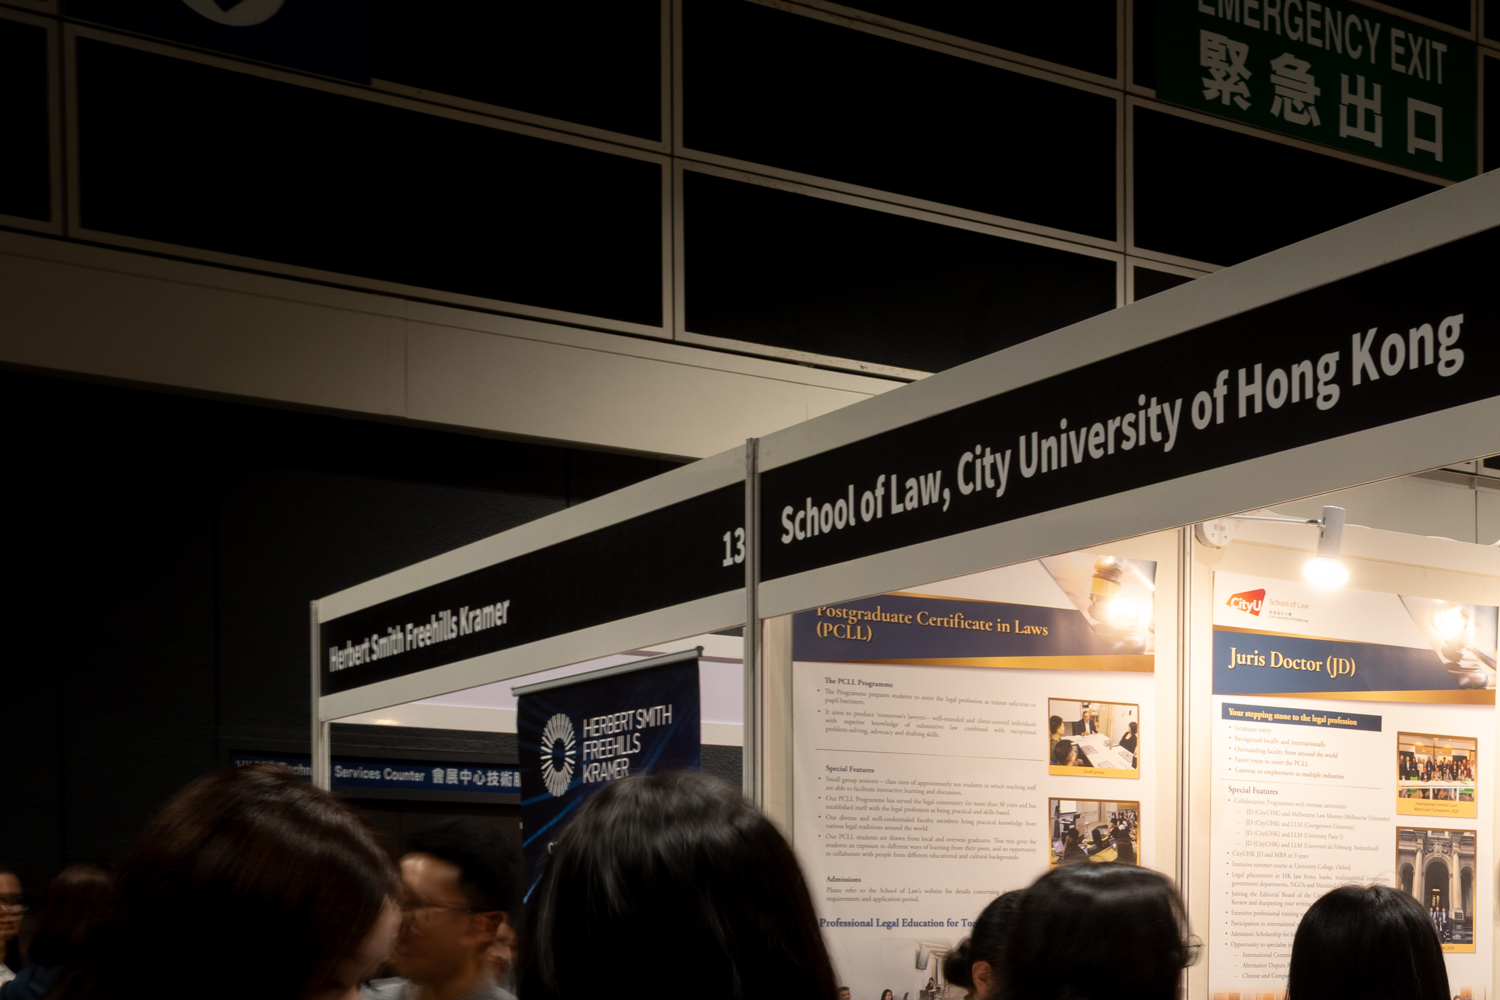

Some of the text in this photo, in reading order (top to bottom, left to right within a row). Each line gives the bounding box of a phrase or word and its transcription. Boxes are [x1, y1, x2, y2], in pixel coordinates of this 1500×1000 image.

[1198, 0, 1447, 84] MERGENCY EXIT
[1200, 29, 1443, 162] 緊急出口
[781, 312, 1464, 544] School of Law, City University of Hong Kong
[723, 527, 745, 567] 13
[1231, 597, 1262, 612] CityU
[1269, 599, 1289, 607] School
[817, 606, 1049, 636] Postgraduate Certificate in Laws
[329, 600, 510, 672] Herbert Smith Freehills Kramer
[816, 621, 872, 642] (PCLL)
[1228, 647, 1355, 678] Juris Doctor (JD)
[858, 679, 893, 688] Programme
[583, 704, 672, 738] HERBERT SMITH
[1229, 708, 1357, 726] Your stepping stone to the legal profession
[1234, 725, 1257, 733] Graduate
[583, 733, 641, 761] FREEHILLS
[1235, 735, 1262, 744] Recognised
[1264, 738, 1279, 746] locally
[1291, 739, 1326, 748] internationally
[1235, 746, 1265, 755] Outstanding
[1267, 747, 1283, 756] faculty
[1285, 748, 1296, 756] from
[334, 765, 425, 782] Services Counter
[583, 758, 629, 784] KRAMER
[826, 765, 847, 773] Special
[1235, 767, 1256, 775] Gateway
[1264, 769, 1294, 777] employment
[1302, 771, 1321, 779] multiple
[1323, 772, 1344, 780] industries
[1228, 785, 1278, 795] Special Features
[845, 823, 857, 831] legal
[819, 918, 873, 928] Professional
[876, 918, 899, 930] Legal
[902, 919, 944, 928] Education
[947, 918, 959, 927] for
